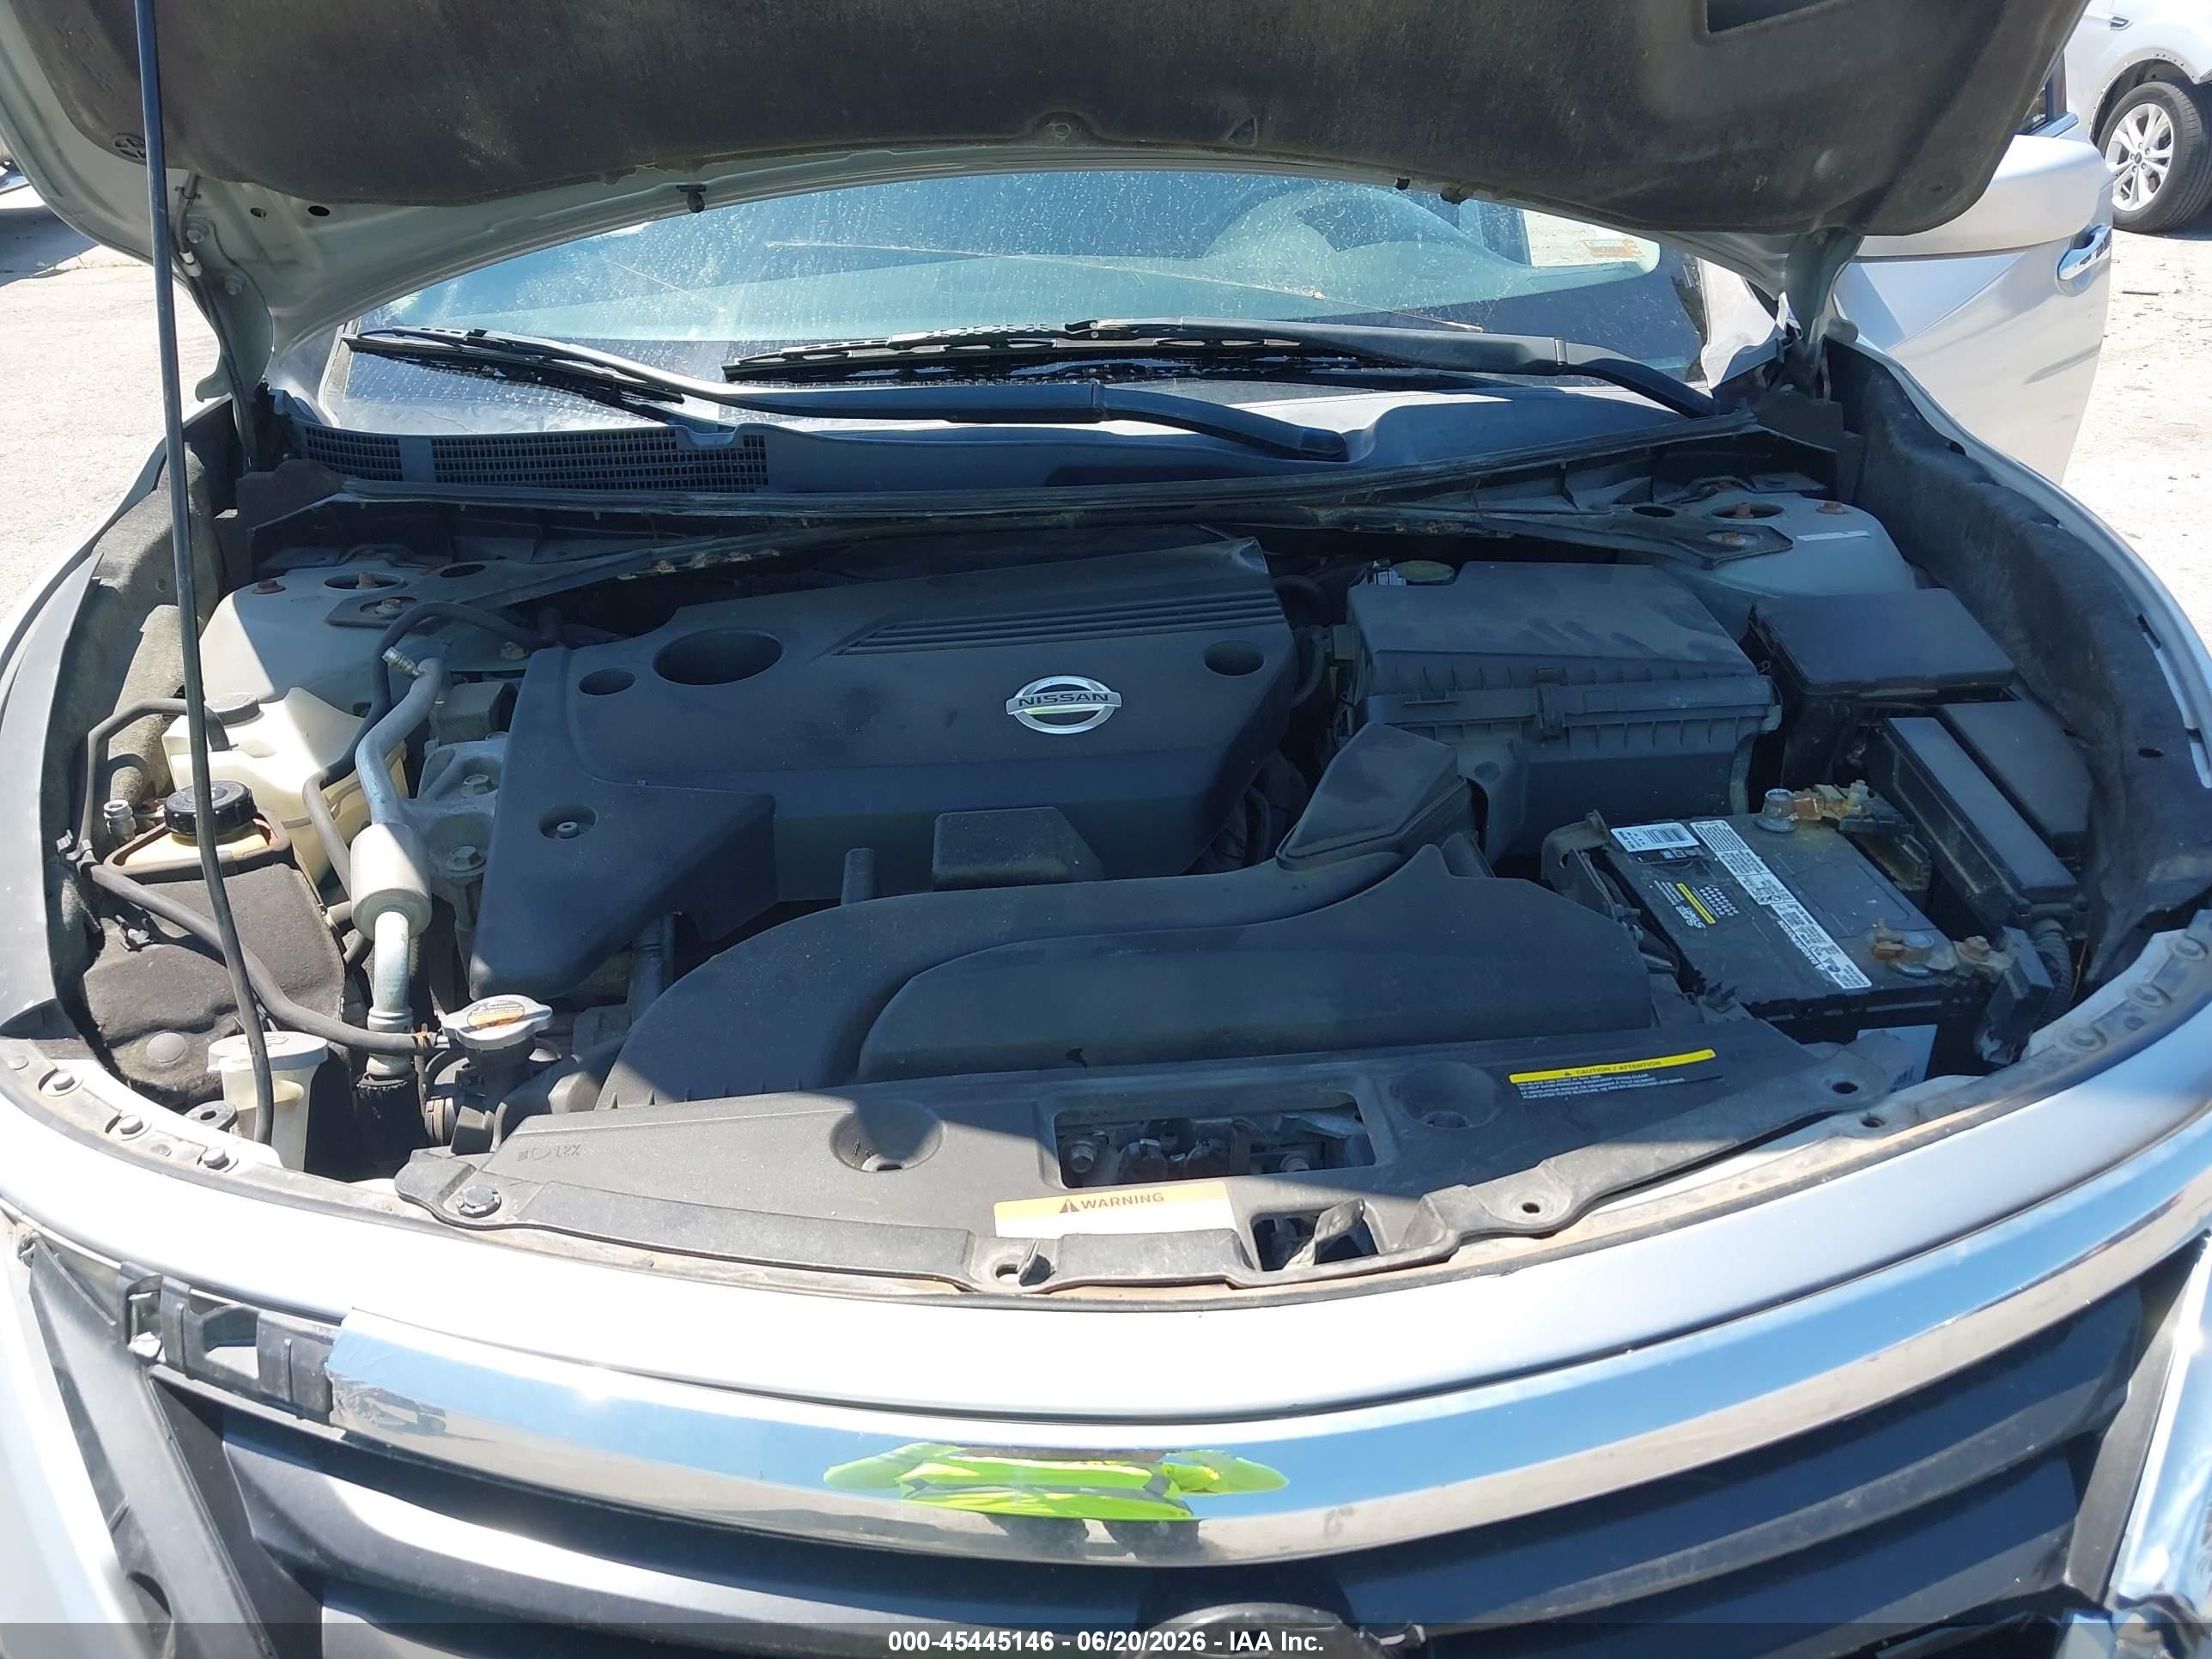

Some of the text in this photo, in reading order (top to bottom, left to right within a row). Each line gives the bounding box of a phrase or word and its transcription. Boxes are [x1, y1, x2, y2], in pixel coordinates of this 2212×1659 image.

[1018, 693, 1109, 708] NISSAN
[1576, 1066, 1612, 1075] CAUTION
[1619, 1060, 1662, 1071] ATTENTION
[1080, 1191, 1165, 1211] WARNING
